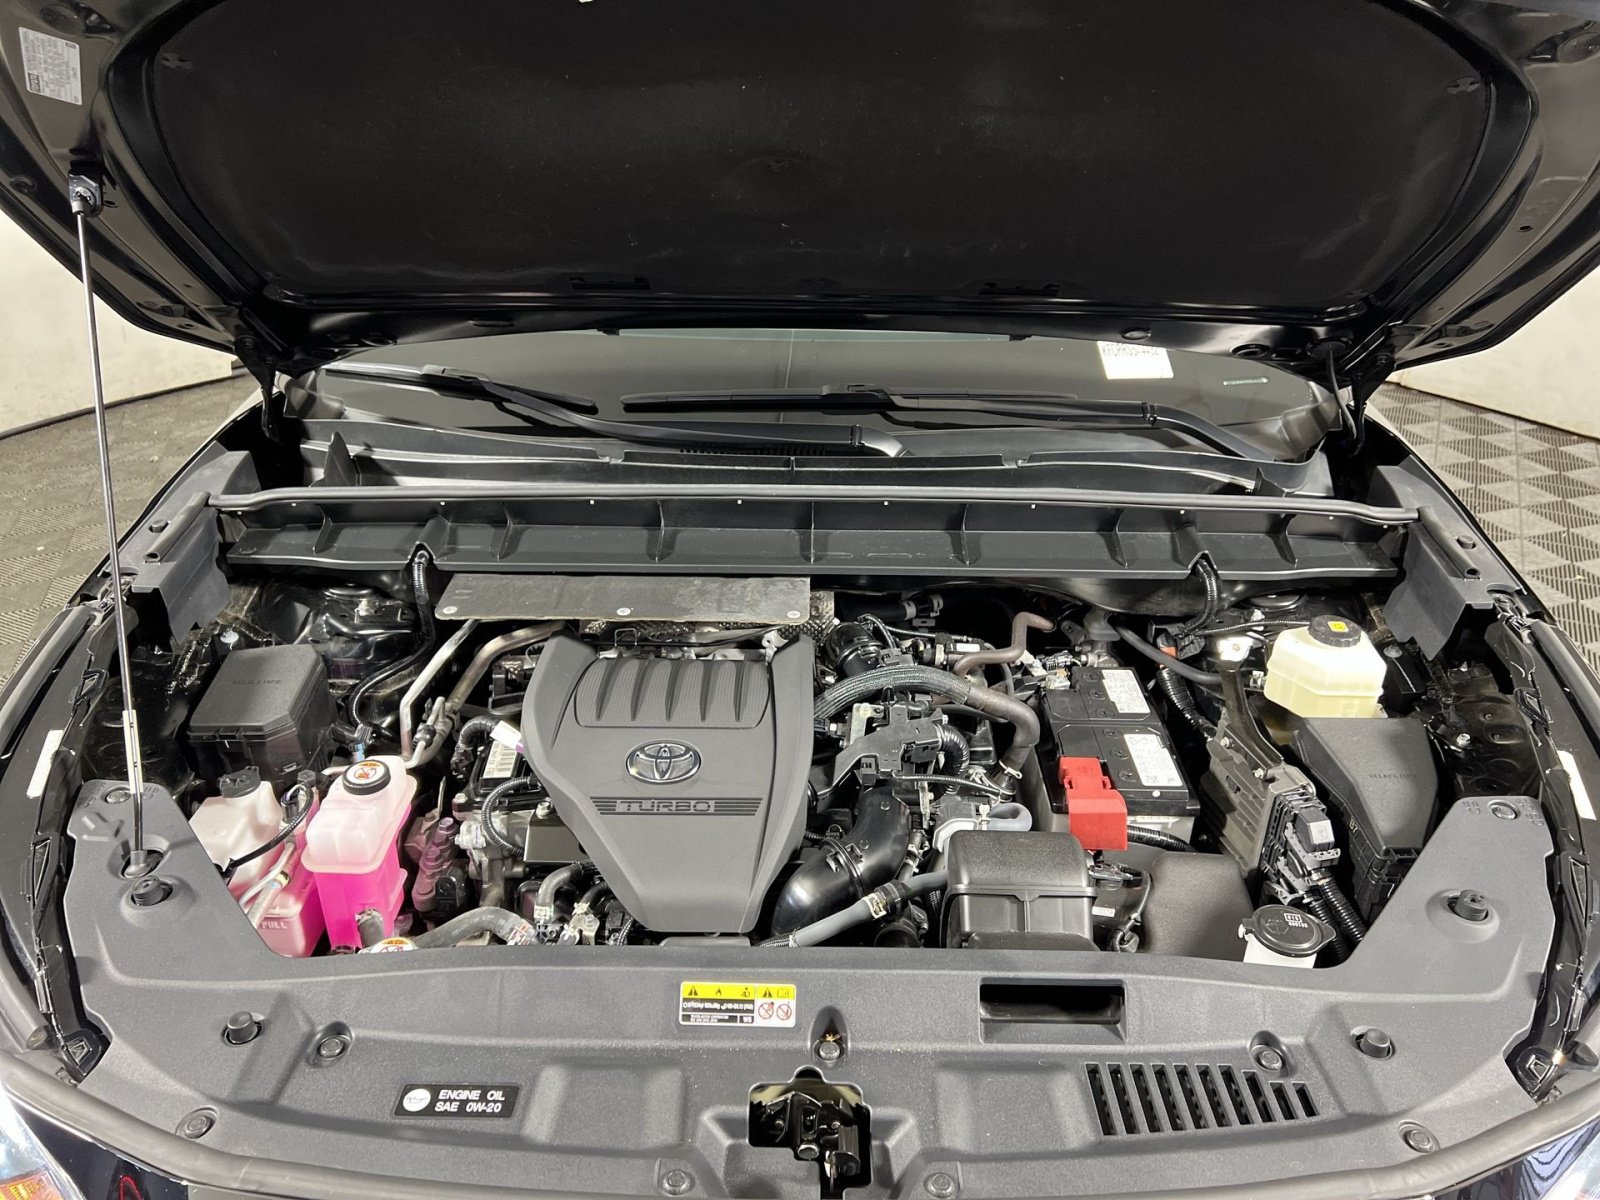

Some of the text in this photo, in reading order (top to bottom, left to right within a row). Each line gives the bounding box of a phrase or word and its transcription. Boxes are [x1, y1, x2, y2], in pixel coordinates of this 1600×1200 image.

[620, 800, 711, 812] TURBO
[438, 1089, 505, 1101] ENGINE OIL
[434, 1101, 502, 1113] SAE 0W-20
